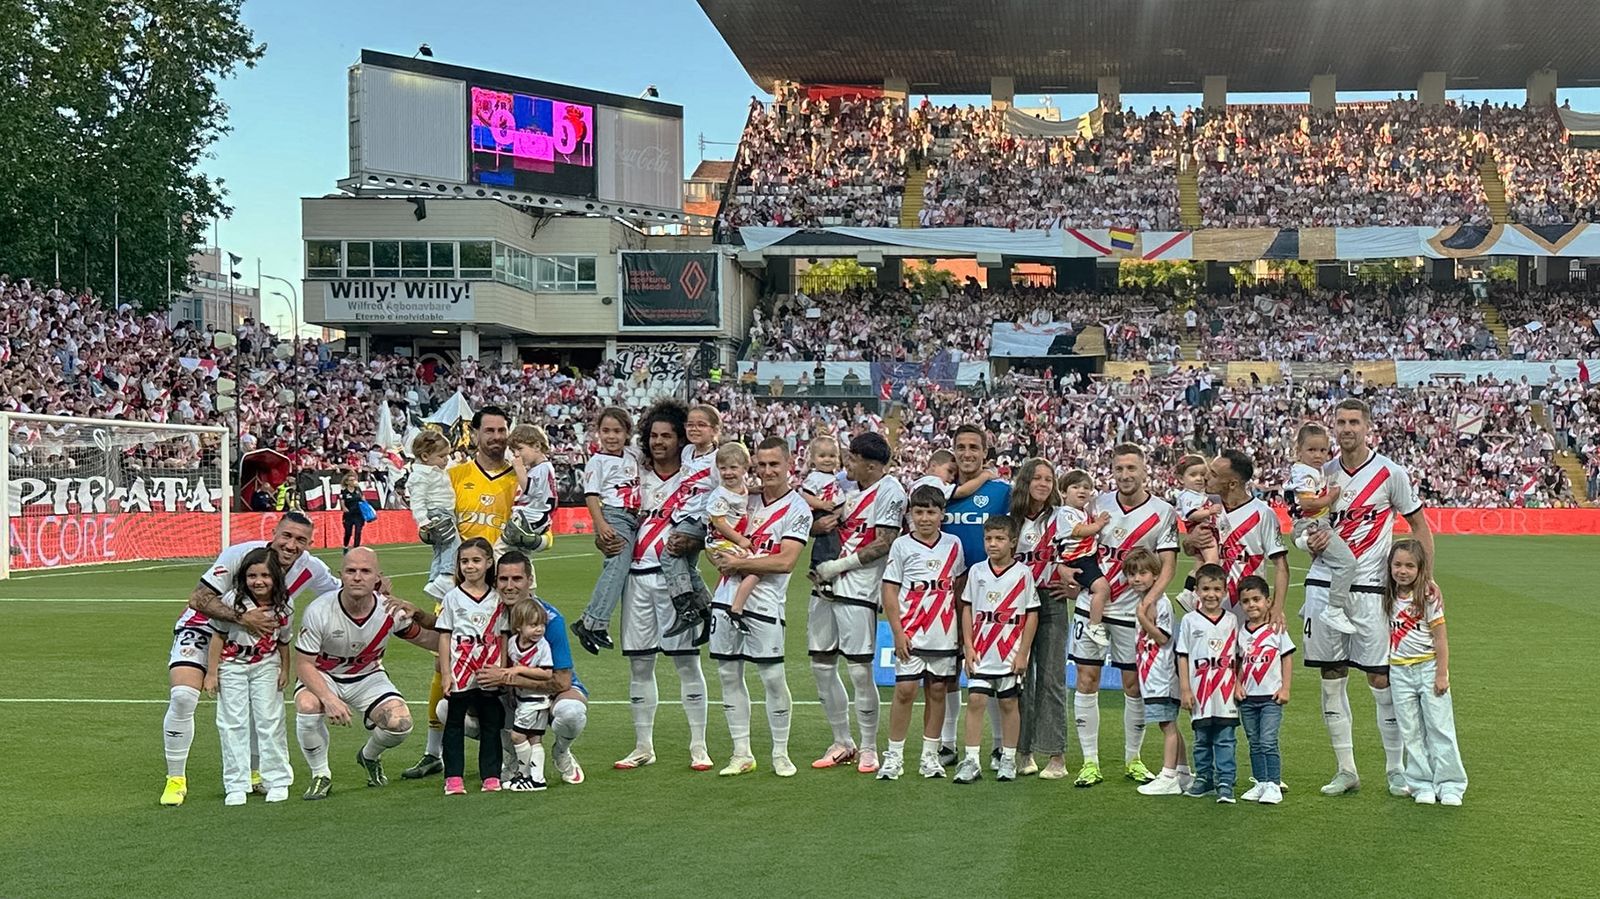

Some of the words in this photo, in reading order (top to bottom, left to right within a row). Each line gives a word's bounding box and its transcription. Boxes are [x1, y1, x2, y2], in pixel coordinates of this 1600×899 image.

[330, 281, 396, 303] Willy!
[404, 281, 470, 303] Willy!
[348, 301, 383, 311] Wilfred
[386, 301, 451, 311] Agbonavbare
[355, 313, 385, 321] Eterno
[395, 313, 444, 321] inolvidable
[9, 476, 217, 516] PIRATA
[1394, 508, 1554, 534] NCORE
[975, 610, 1020, 625] DIGI
[180, 631, 208, 650] 22
